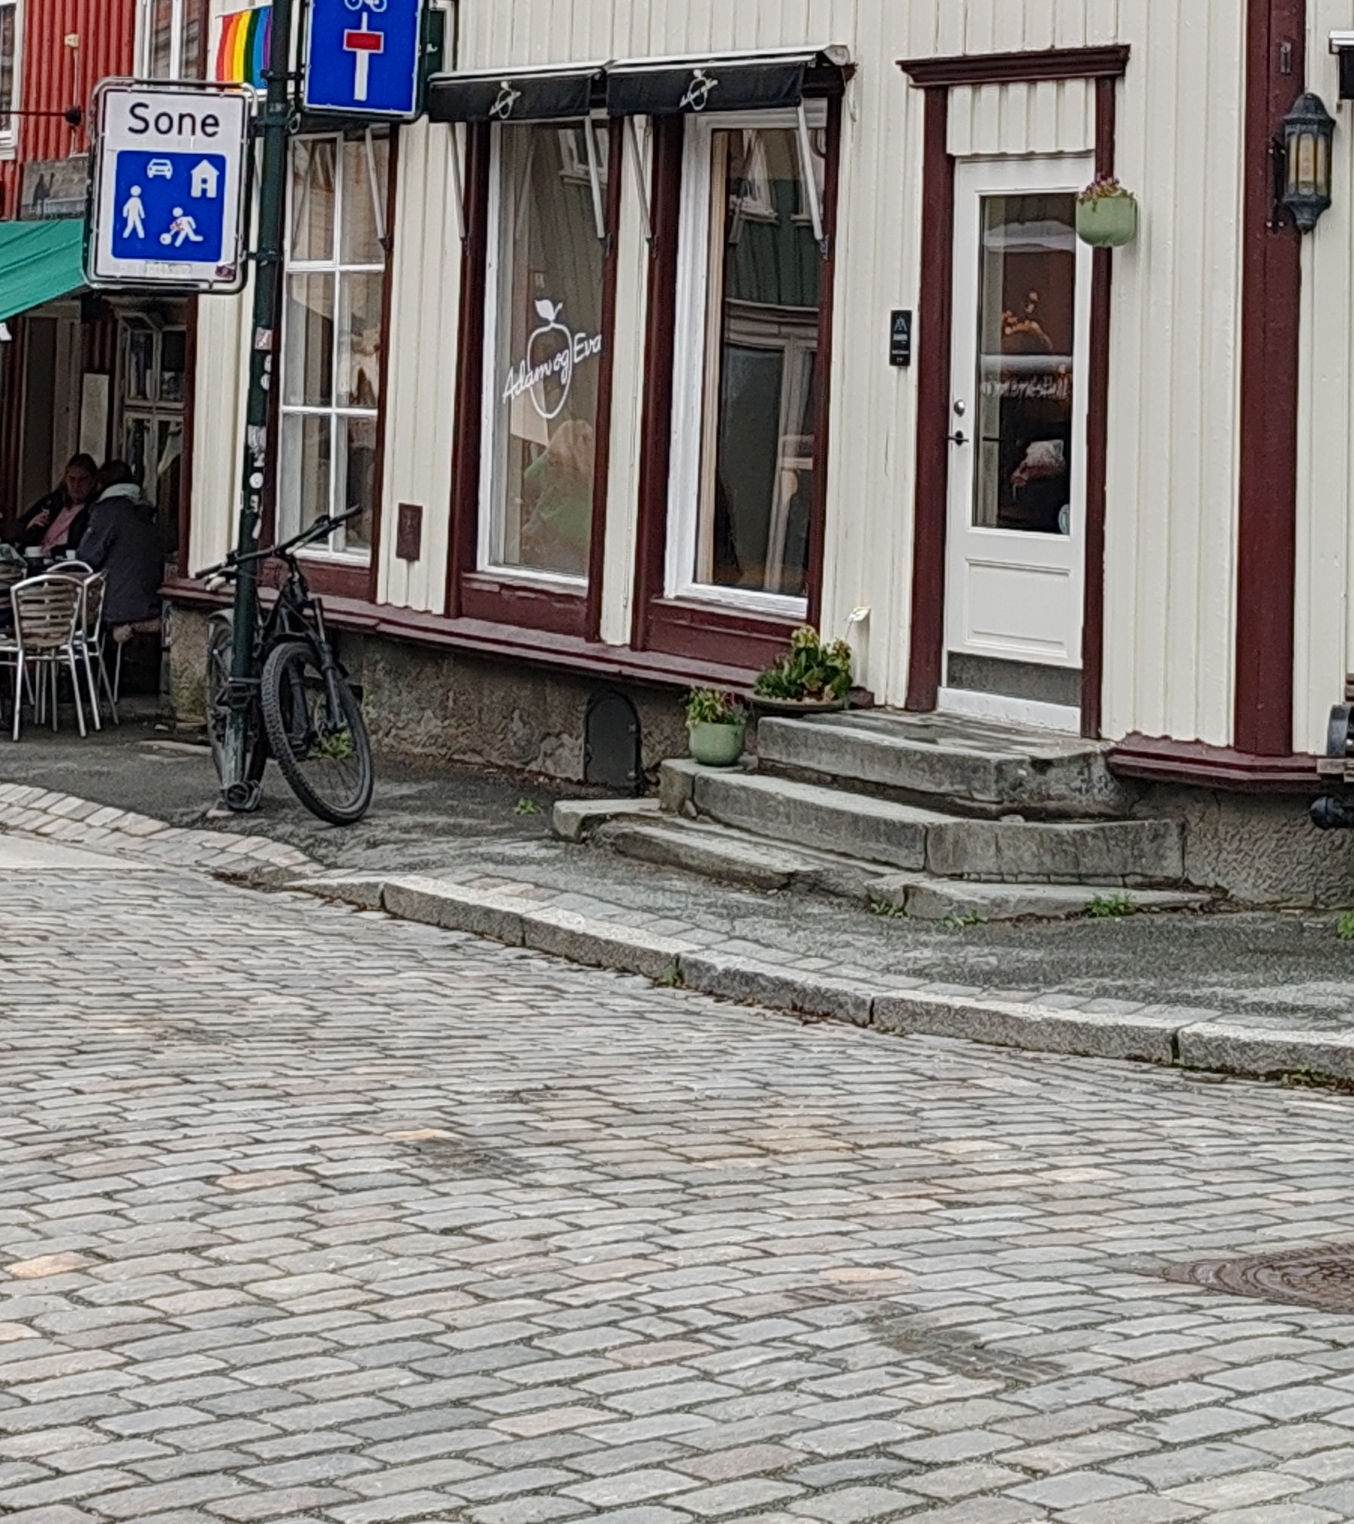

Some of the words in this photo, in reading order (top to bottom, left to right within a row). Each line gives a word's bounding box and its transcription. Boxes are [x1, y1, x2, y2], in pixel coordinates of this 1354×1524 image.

[128, 102, 221, 138] Sone
[502, 359, 553, 405] Adam
[553, 349, 570, 385] og
[573, 332, 602, 364] Eva
